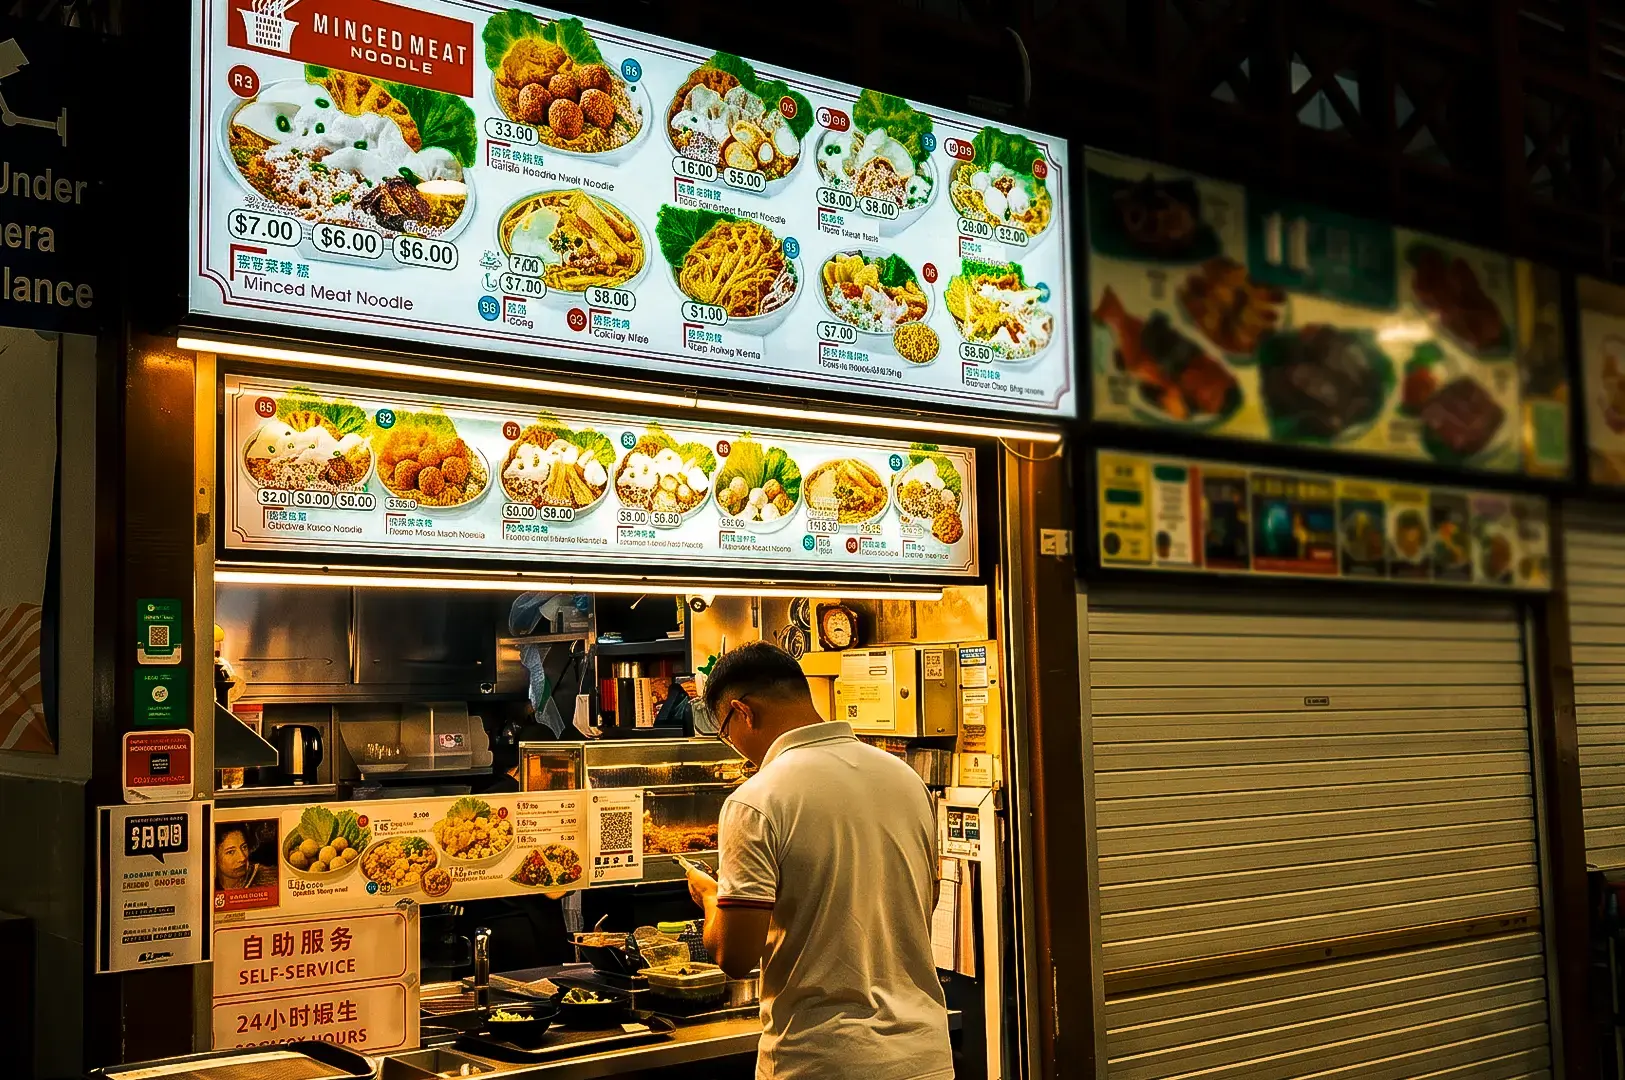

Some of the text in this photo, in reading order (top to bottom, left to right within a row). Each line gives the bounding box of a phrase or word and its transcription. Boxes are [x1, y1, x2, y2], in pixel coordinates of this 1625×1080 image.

[313, 12, 467, 66] MINCED MEAT
[350, 45, 434, 75] NOODLE
[234, 213, 452, 265] $7.00 $6.00 $6.00
[244, 275, 414, 311] Minced Meat Noodle
[242, 926, 353, 961] 自助服务
[239, 958, 356, 986] SELF-SERVICE
